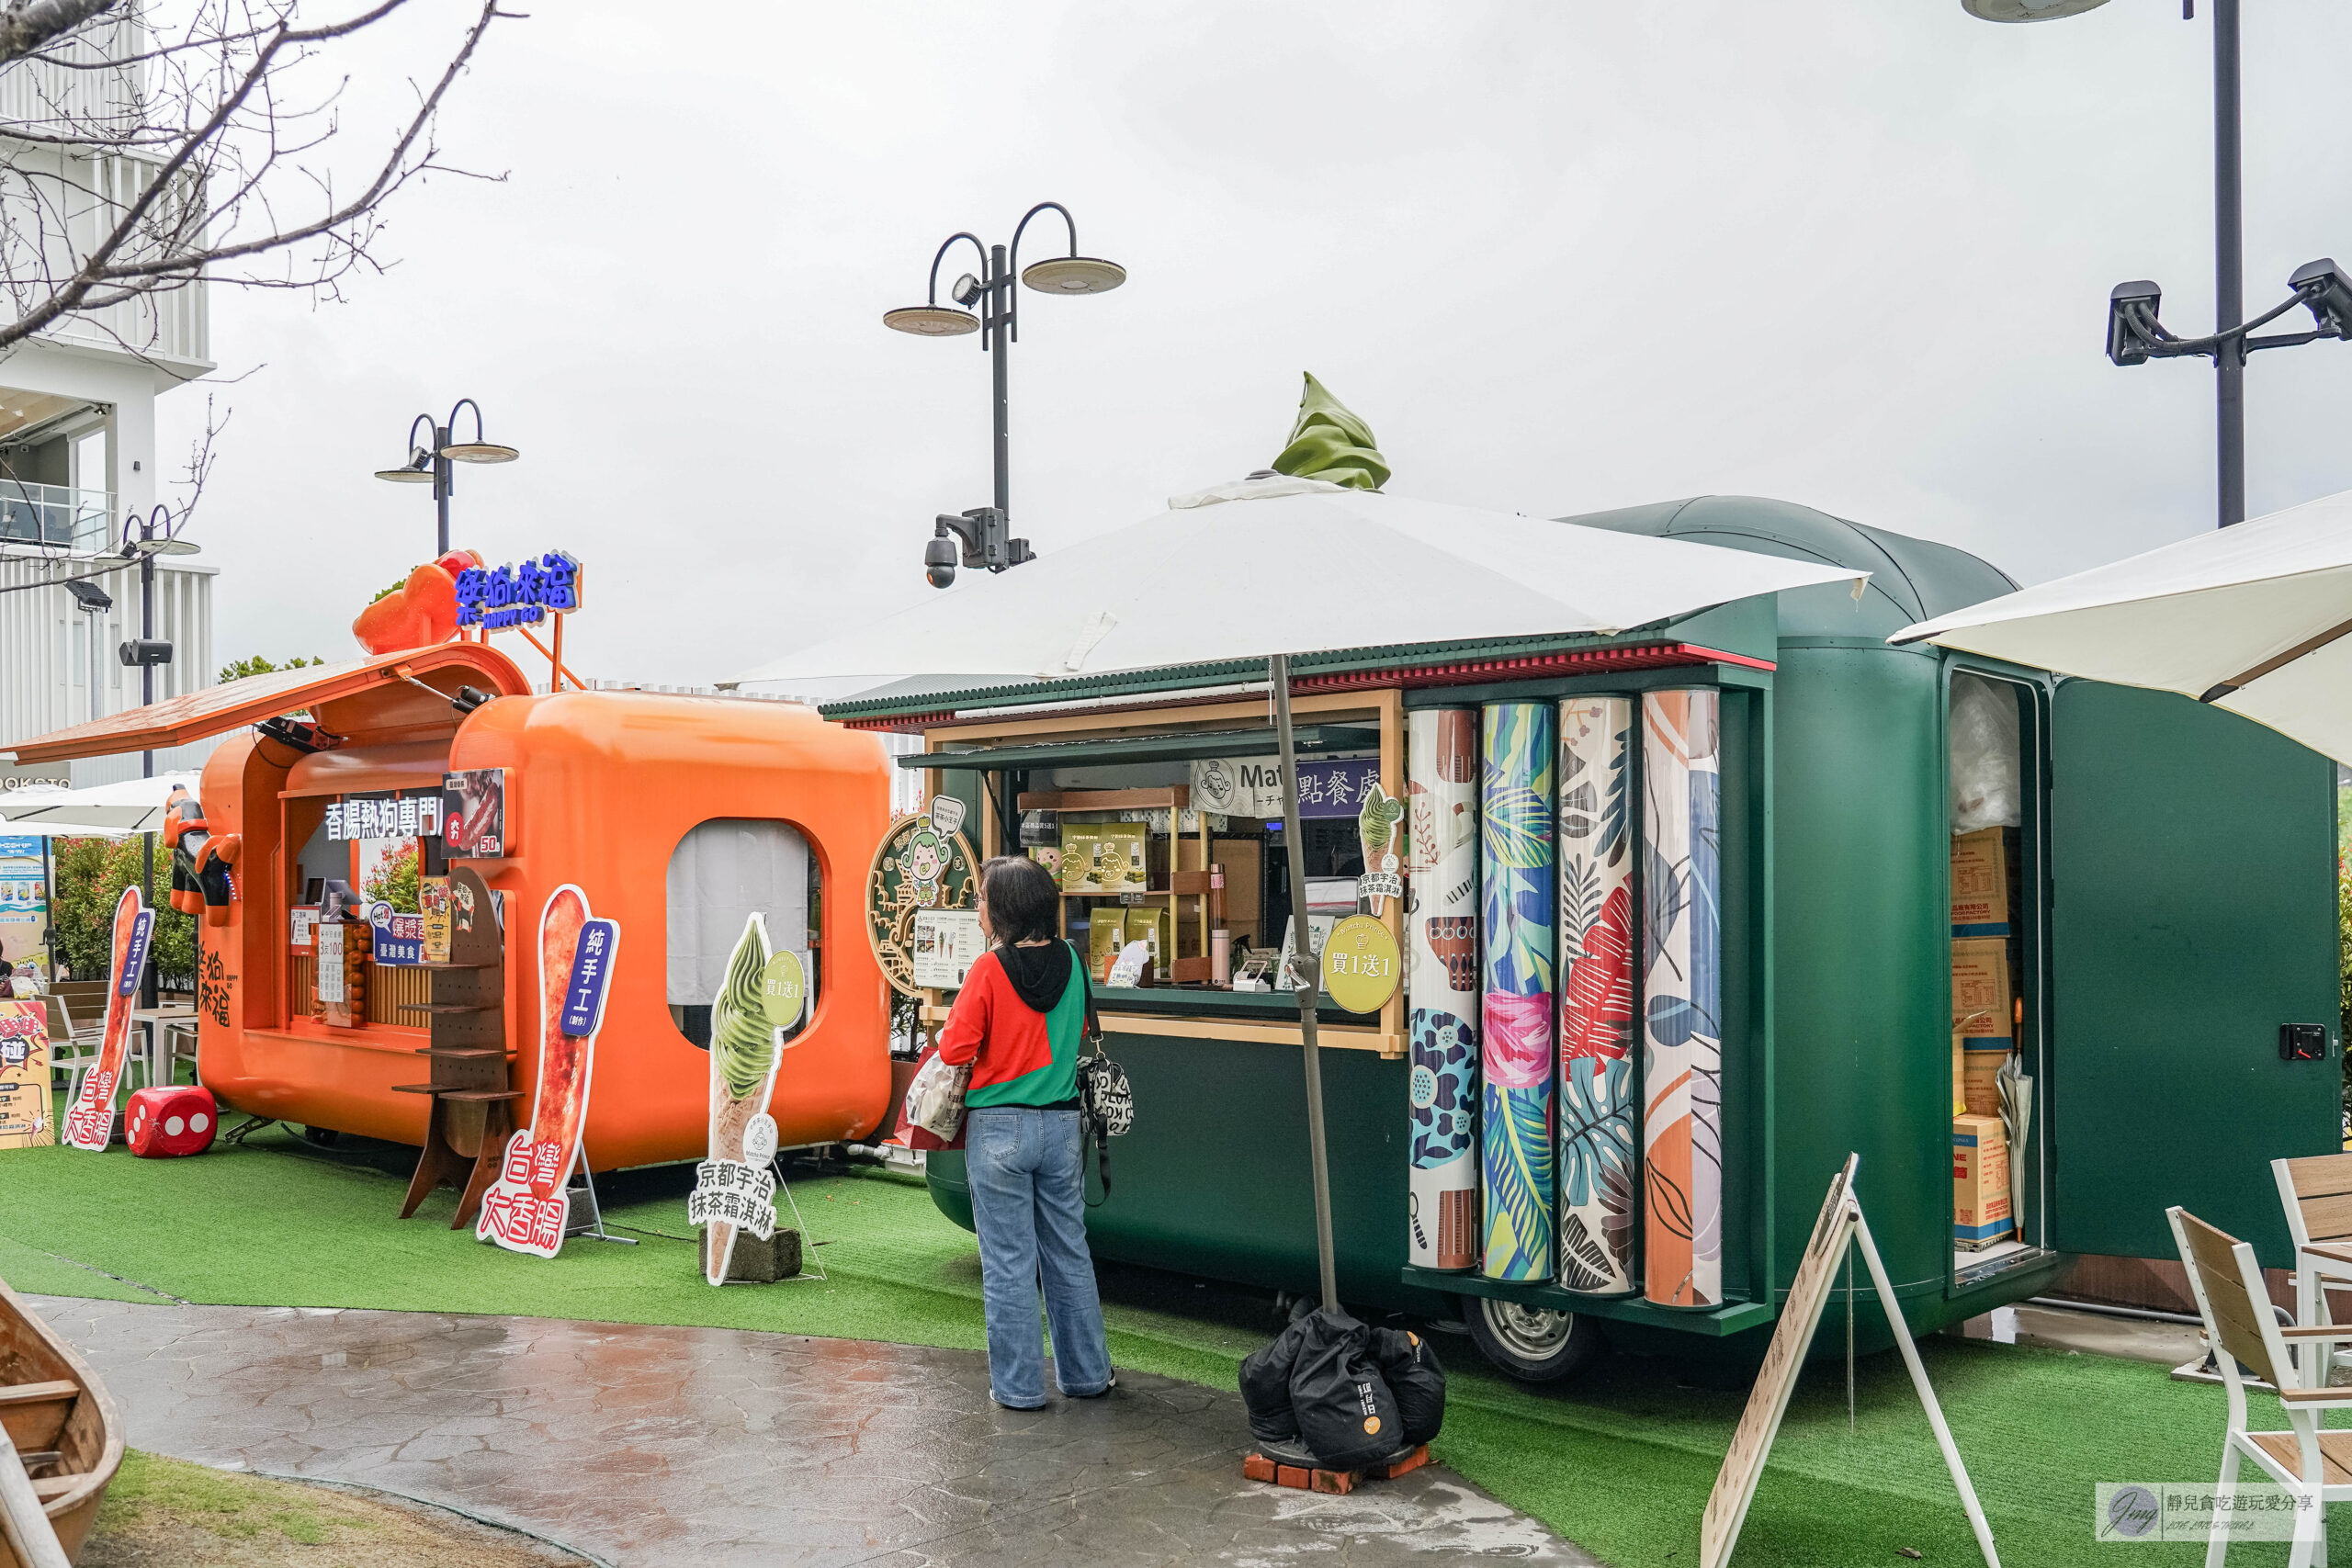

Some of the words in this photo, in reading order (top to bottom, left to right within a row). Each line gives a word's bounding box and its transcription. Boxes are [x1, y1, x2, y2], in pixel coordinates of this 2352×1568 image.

[483, 608, 518, 629] HAPPY
[520, 605, 540, 623] GO
[0, 777, 71, 791] OKTO
[325, 796, 444, 840] 香腸熱狗專門
[1360, 884, 1400, 896] 抹茶霜淇淋
[1362, 873, 1398, 885] 京都宇治
[373, 911, 384, 920] Hot
[1340, 921, 1365, 936] Matcha
[1364, 921, 1385, 937] Prince
[125, 918, 148, 977] 純手工
[572, 928, 605, 1013] 純手工
[1331, 952, 1390, 977] 買1送1
[765, 977, 799, 999] 買1送1
[1, 1041, 26, 1061] 碰
[82, 1067, 113, 1103] 台灣
[63, 1105, 112, 1146] 大香腸
[507, 1134, 561, 1188] 台灣
[698, 1161, 772, 1199] 京都宇治
[480, 1187, 563, 1250] 大香腸
[691, 1191, 773, 1234] 抹茶霜淇淋
